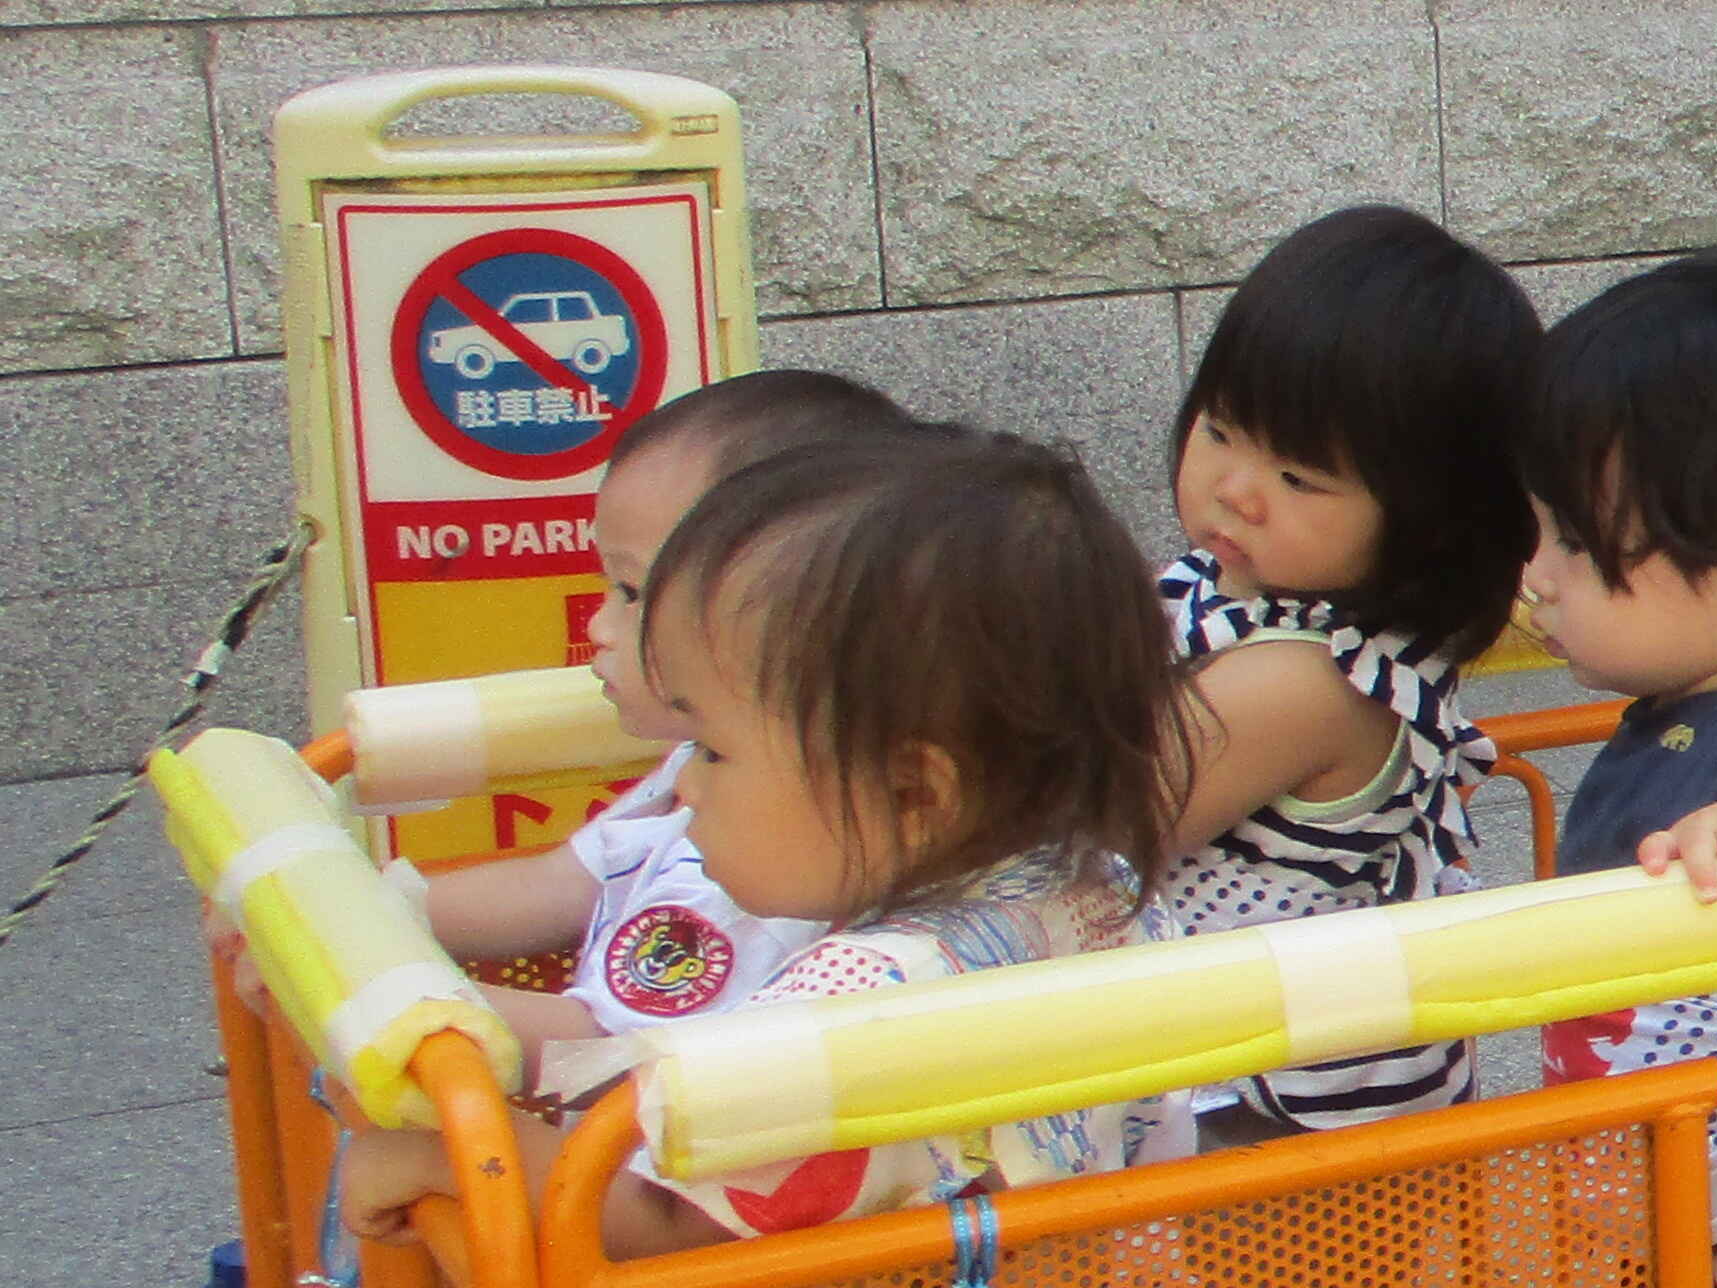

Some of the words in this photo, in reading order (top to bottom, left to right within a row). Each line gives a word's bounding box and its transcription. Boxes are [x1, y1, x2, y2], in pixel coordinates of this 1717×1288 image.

[457, 384, 613, 429] 駐車禁止
[396, 524, 470, 560] NO
